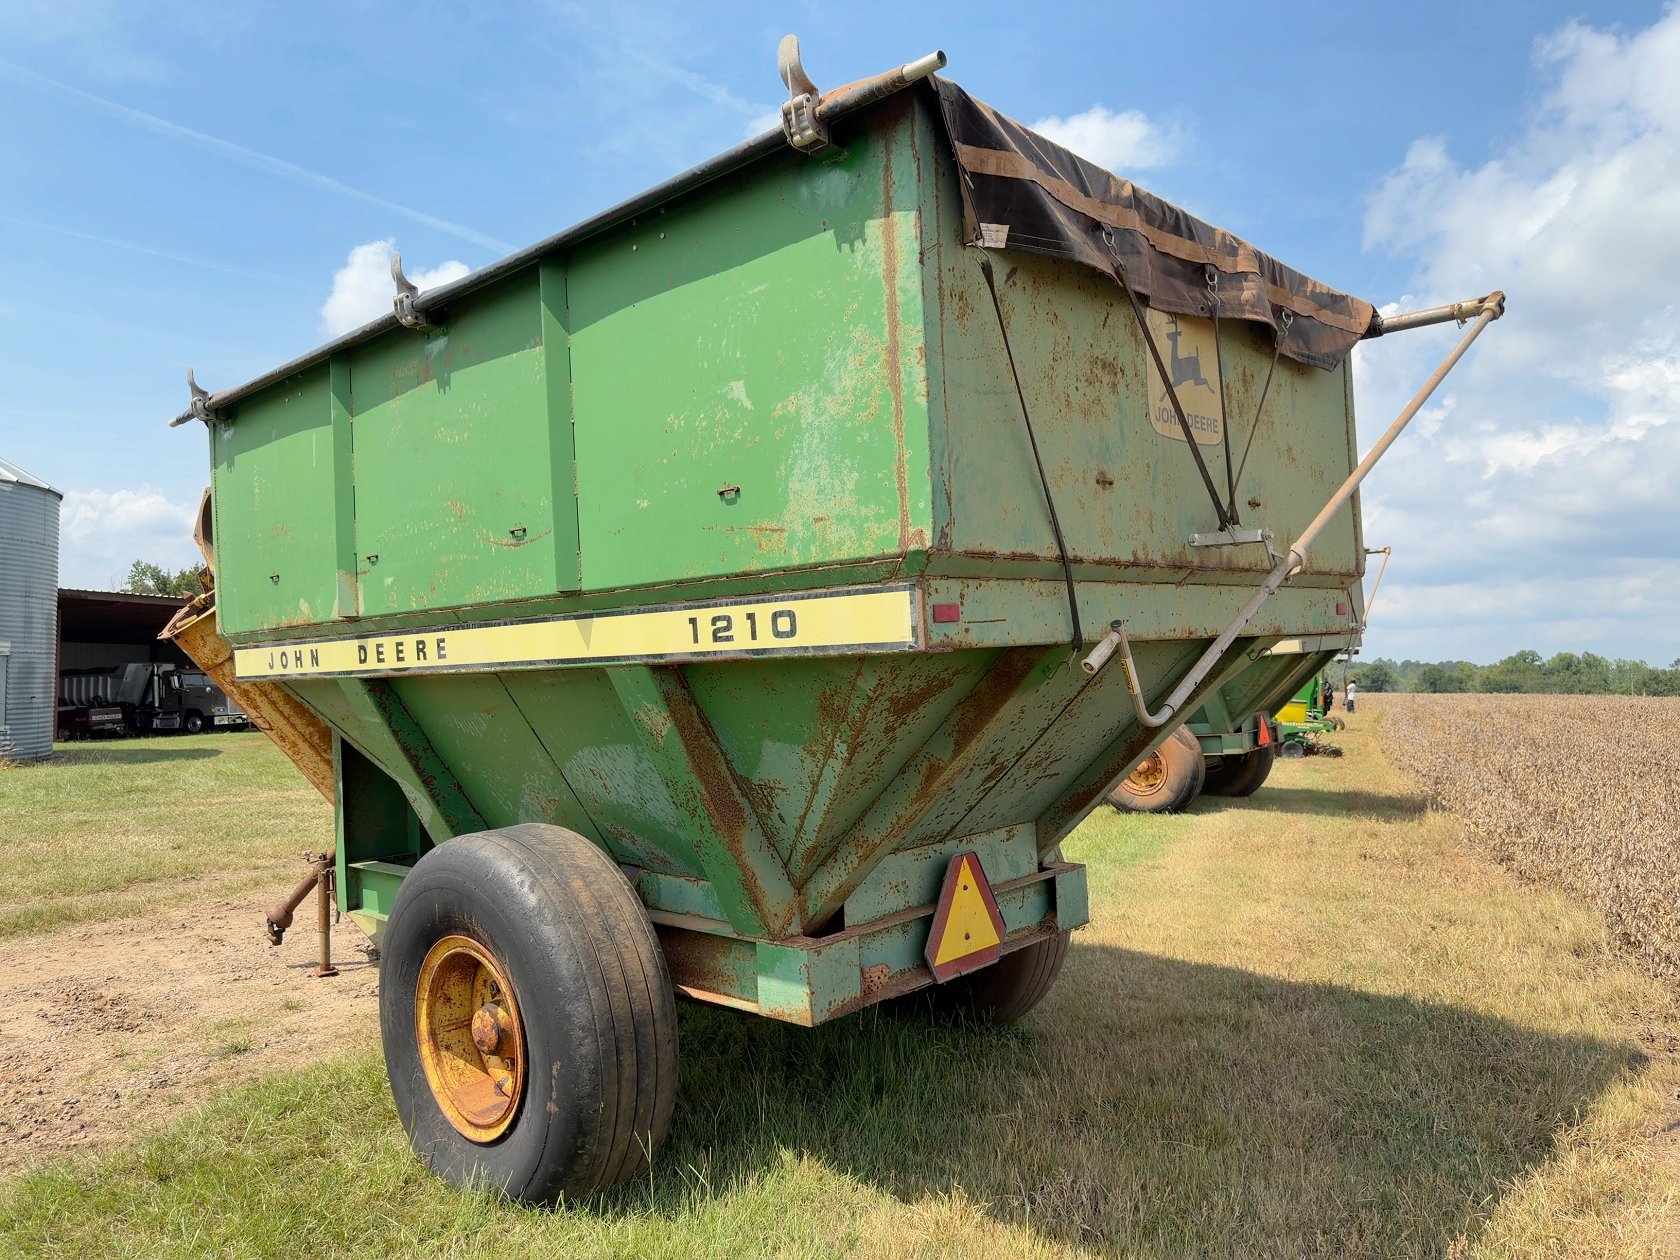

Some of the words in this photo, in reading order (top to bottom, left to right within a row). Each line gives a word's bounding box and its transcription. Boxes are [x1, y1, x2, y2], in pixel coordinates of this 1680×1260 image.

[1155, 406, 1180, 426] JOH
[1187, 413, 1219, 434] DEERE
[268, 648, 320, 670] JOHN
[357, 637, 447, 665] DEERE
[688, 609, 798, 644] 1210
